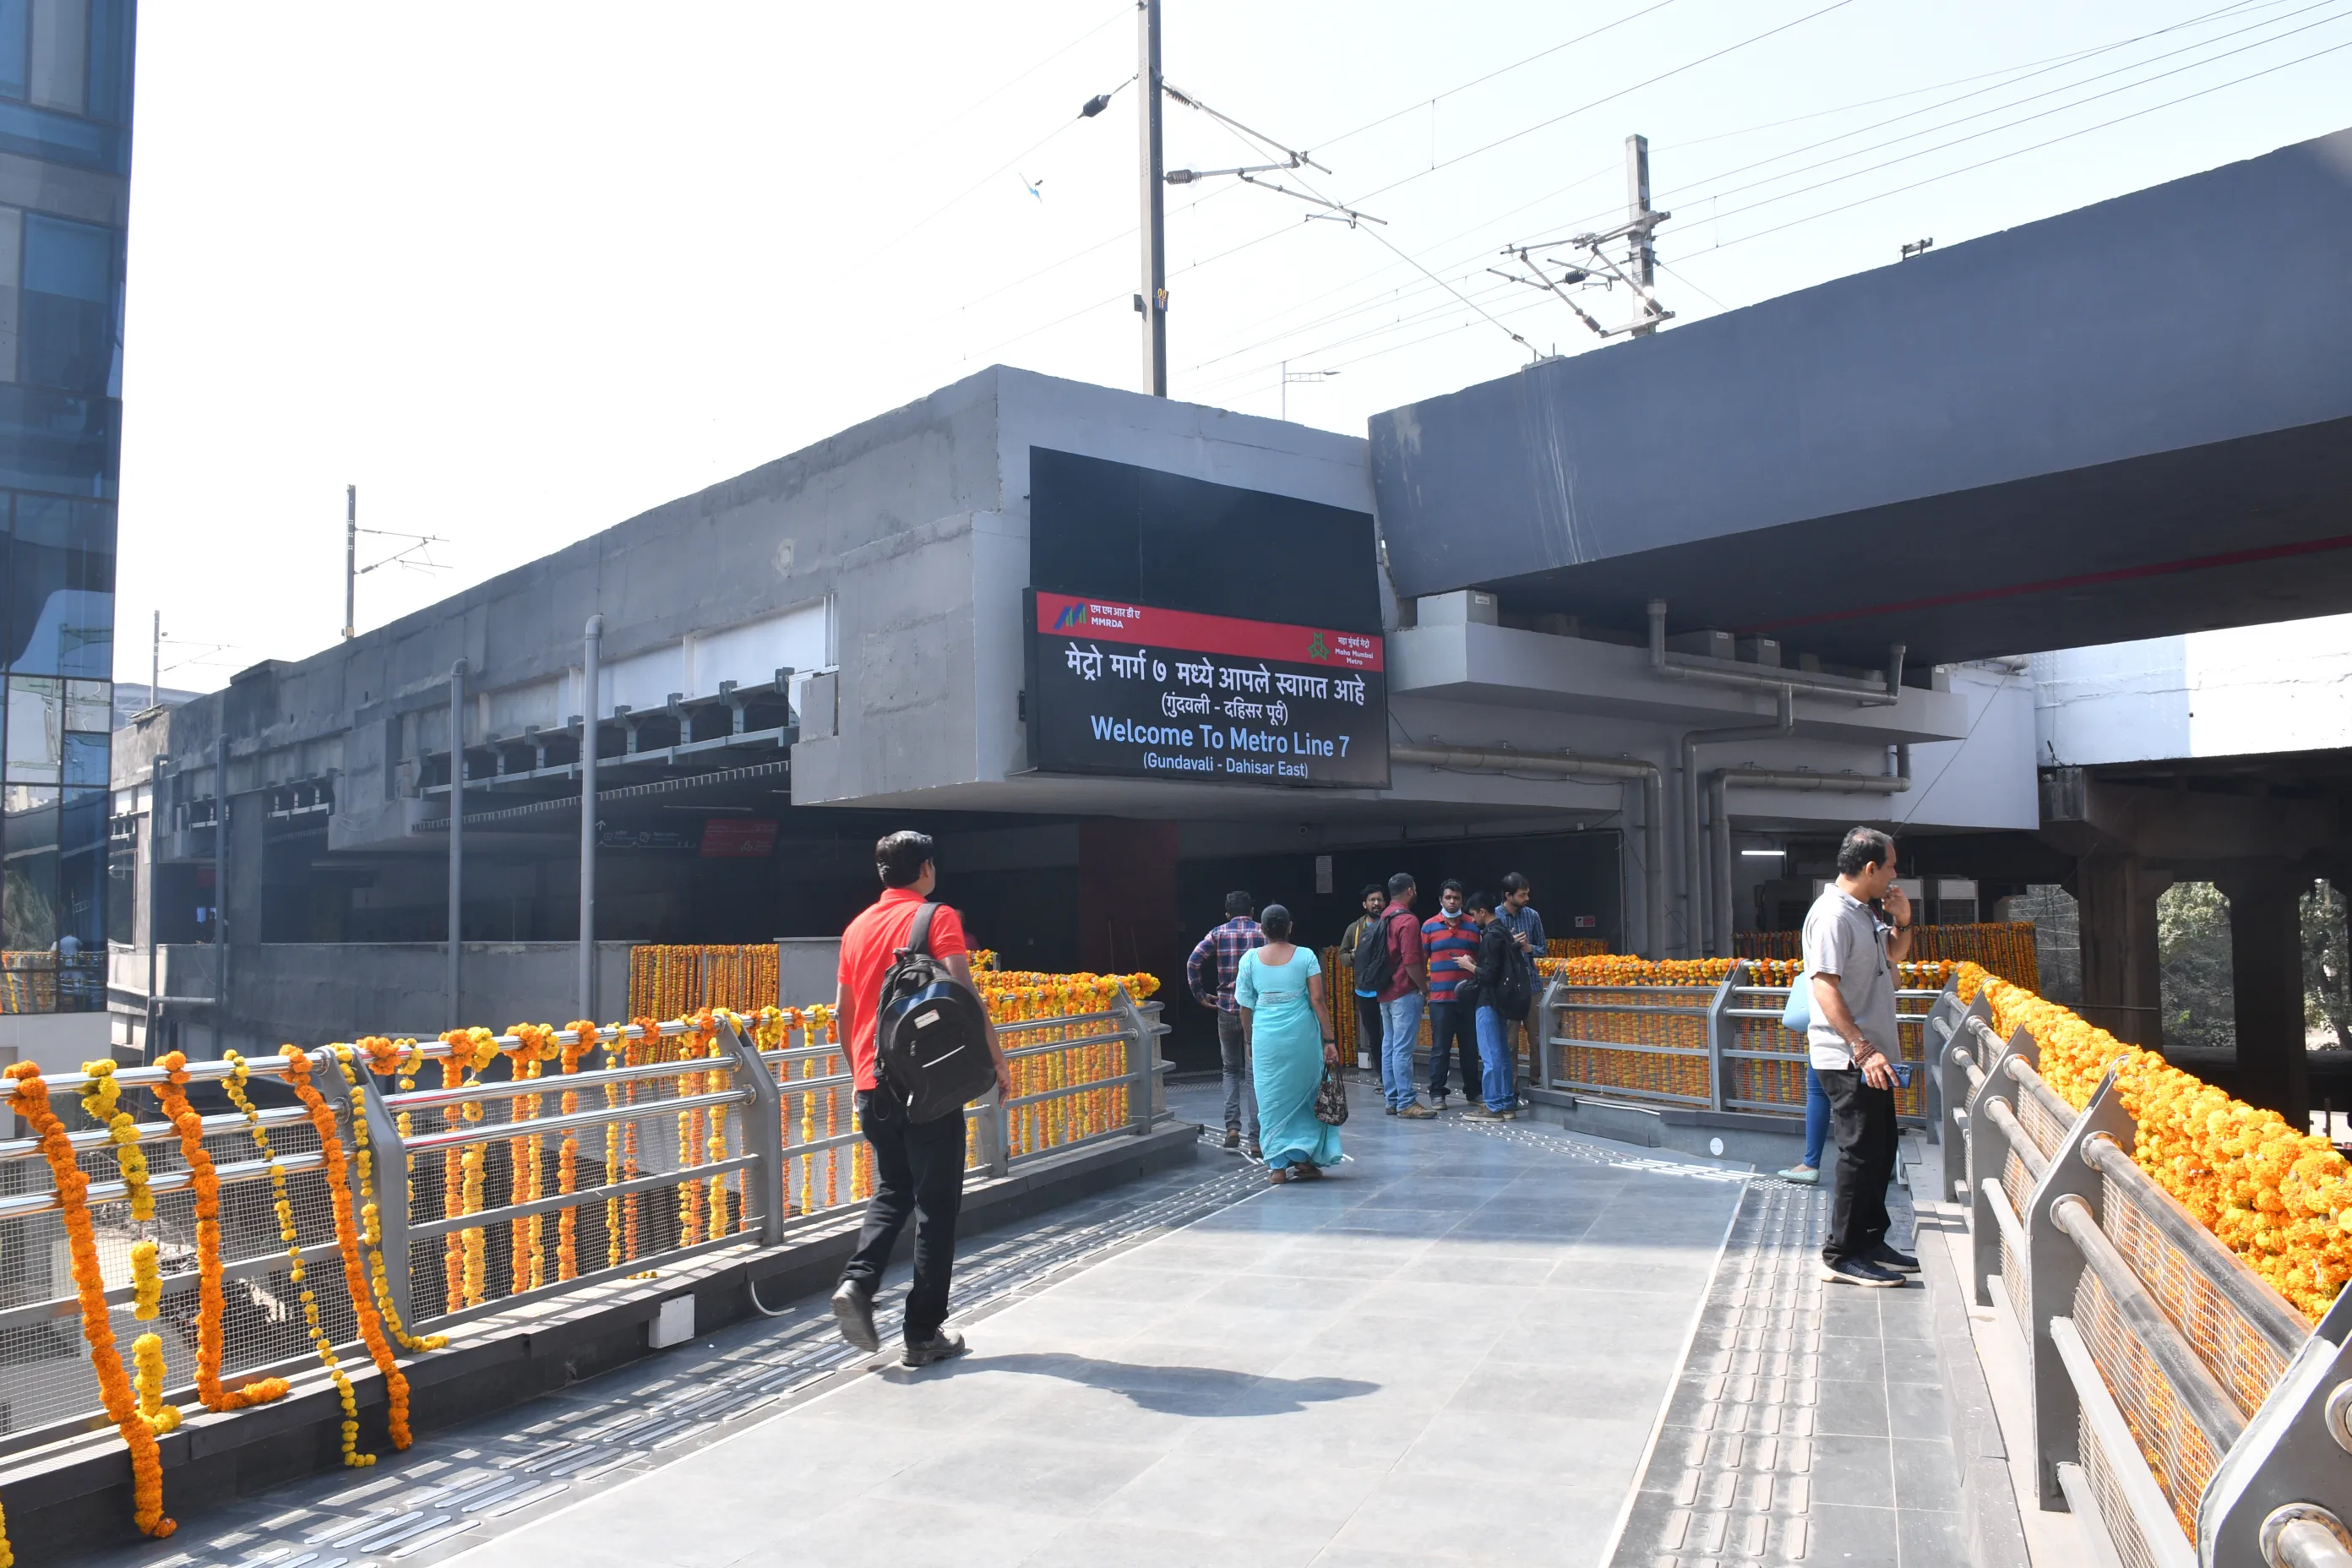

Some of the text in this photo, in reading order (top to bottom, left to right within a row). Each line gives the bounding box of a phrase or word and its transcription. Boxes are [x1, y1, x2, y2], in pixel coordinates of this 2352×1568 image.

[1090, 604, 1141, 619] एम एम आर डी ए
[1091, 617, 1124, 629] MMRDA
[1335, 648, 1374, 659] Maha Mumbai
[1346, 656, 1364, 666] Metro
[1065, 642, 1365, 705] मेट्रो मार्ग ७ मध्ये आपले स्वागत आहे
[1162, 691, 1211, 717] (गुंदवली
[1223, 696, 1263, 720] दहिसर
[1266, 700, 1288, 727] पूर्व)
[1091, 715, 1350, 758] Welcome To Metro Line 7
[1143, 751, 1213, 771] (Gundavali
[1226, 757, 1275, 775] Dahisar
[1278, 760, 1309, 780] East)
